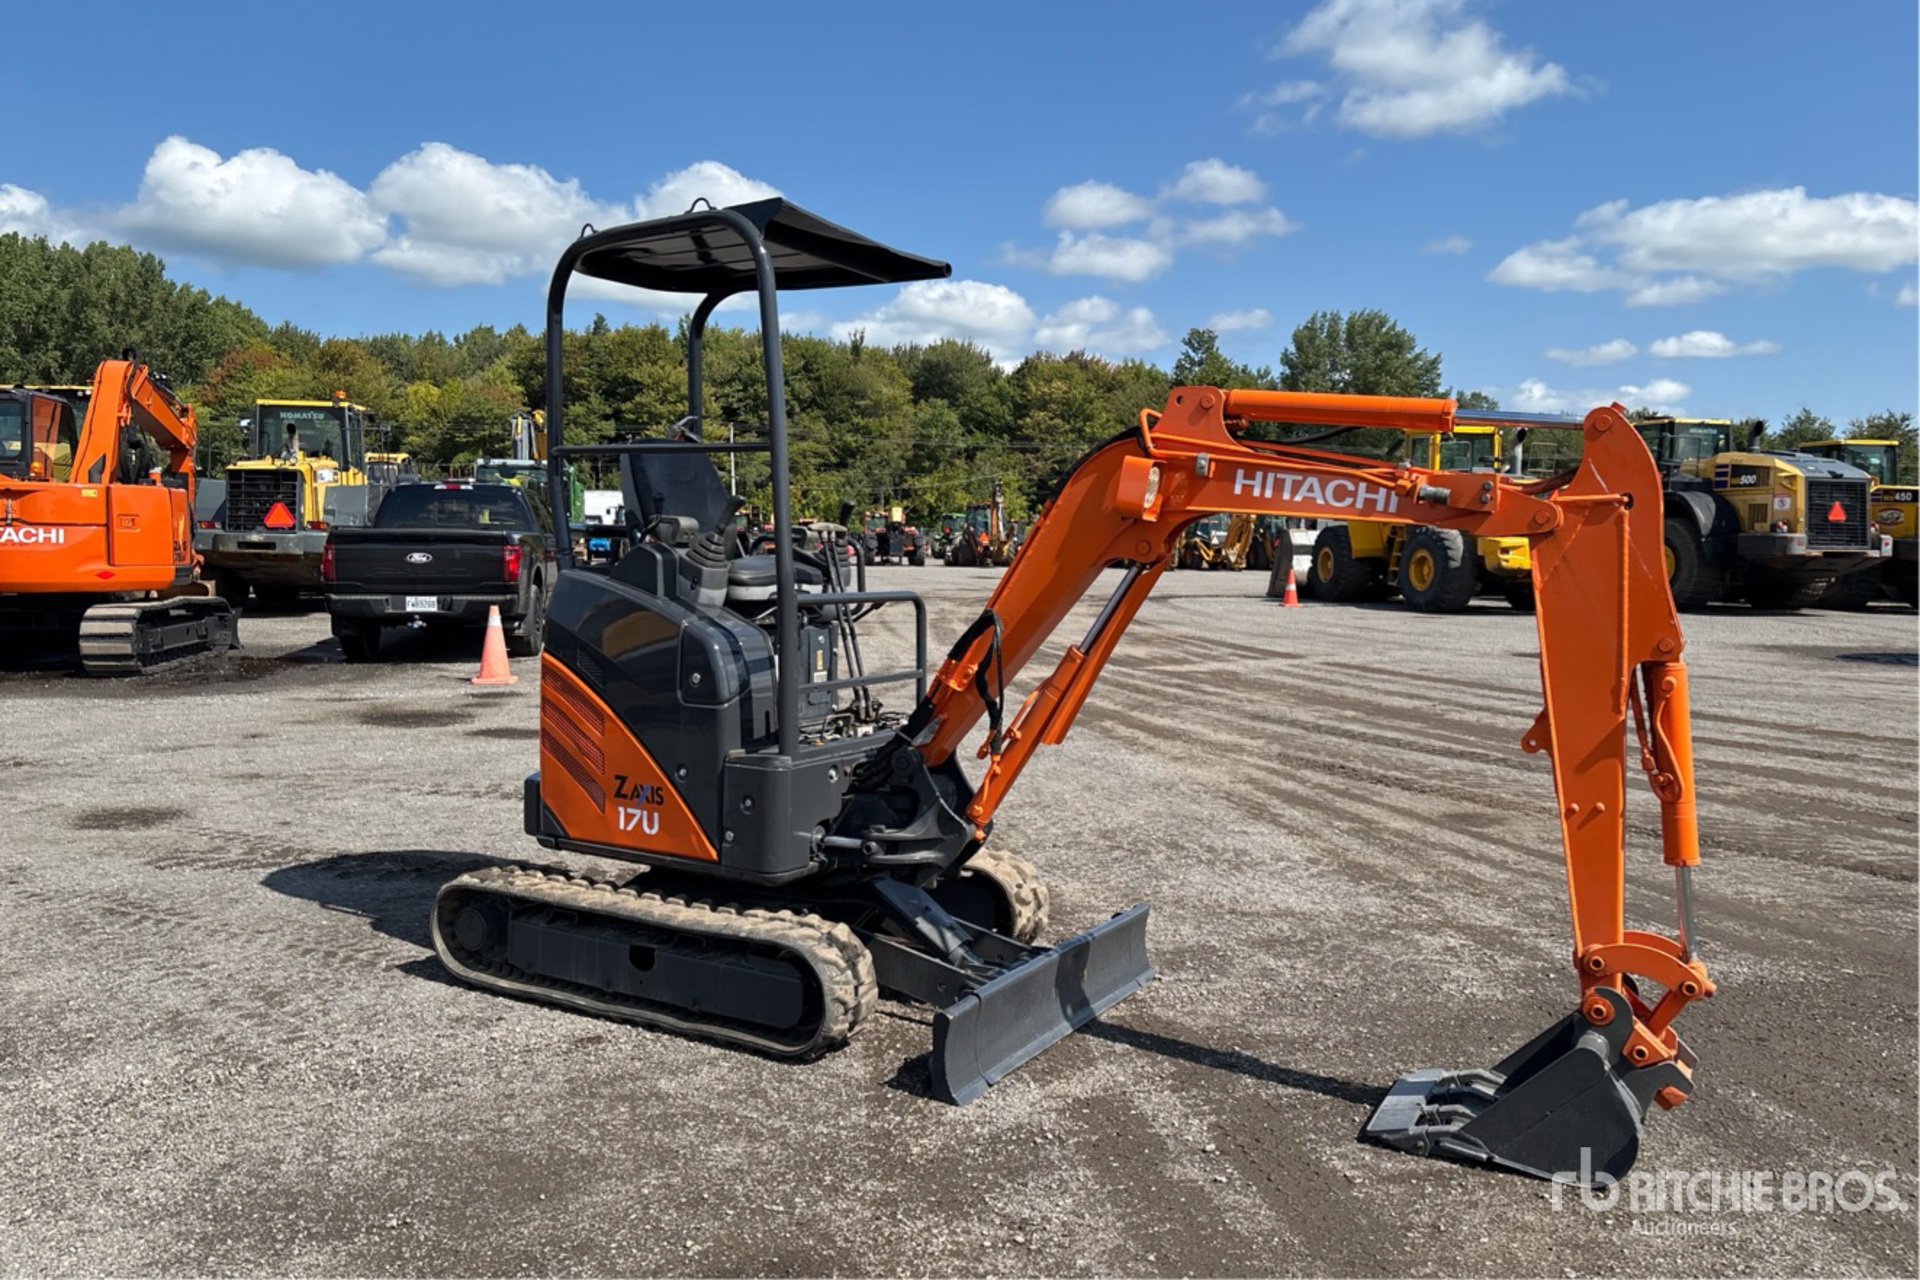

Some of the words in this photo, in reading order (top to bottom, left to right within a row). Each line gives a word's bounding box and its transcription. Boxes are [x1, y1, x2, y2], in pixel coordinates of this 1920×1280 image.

[280, 411, 324, 419] KOMATSU
[1740, 475, 1757, 484] 500
[1234, 469, 1398, 513] HITACHI
[1895, 492, 1913, 501] 450
[0, 527, 65, 544] ACHI
[618, 806, 659, 835] 17U
